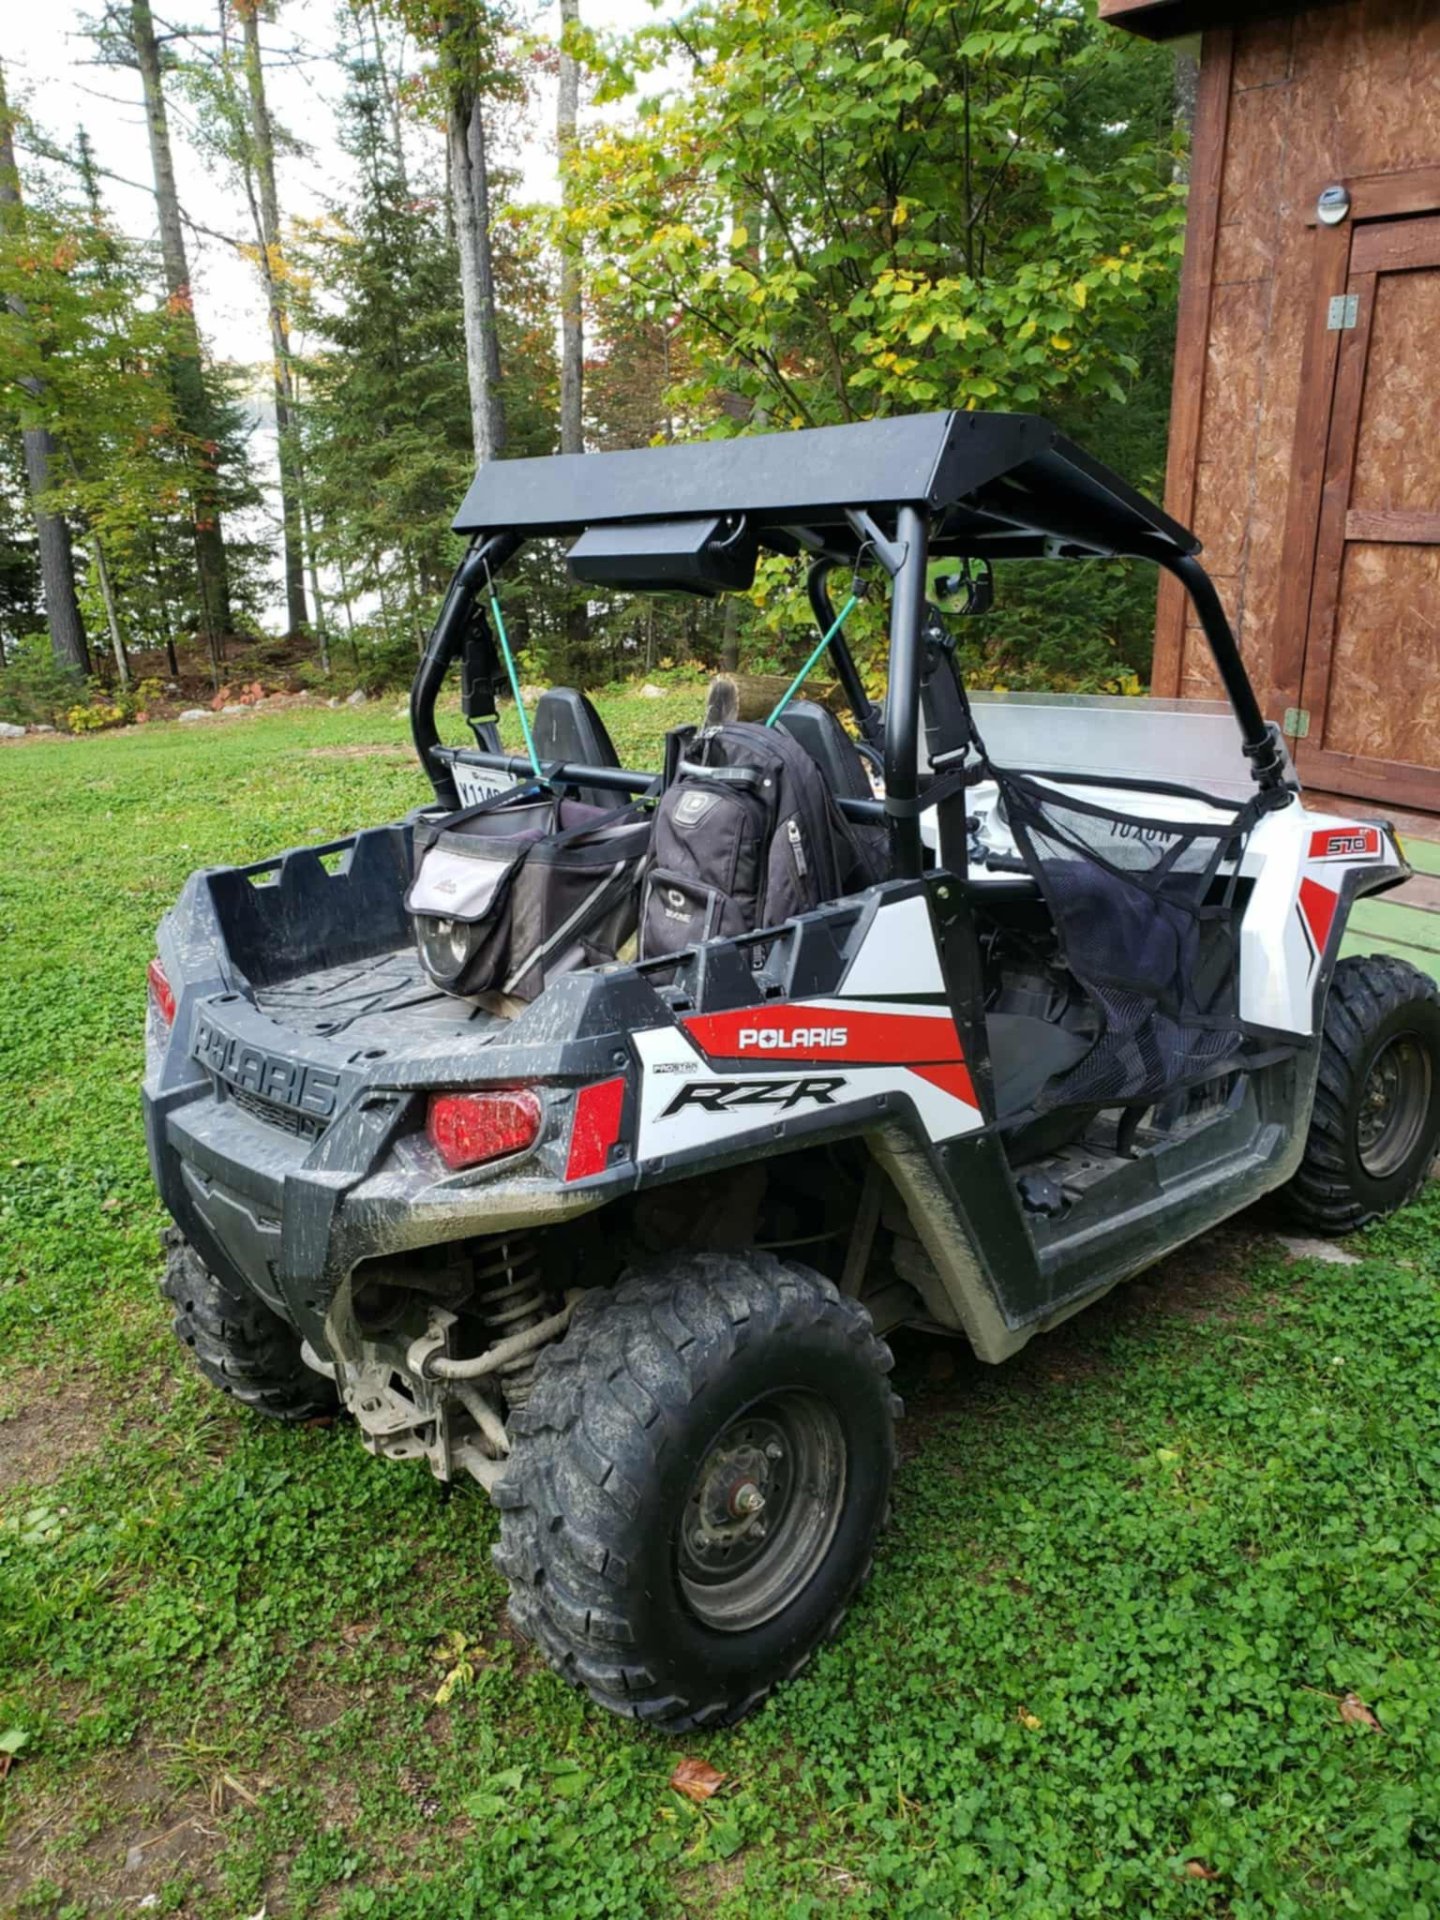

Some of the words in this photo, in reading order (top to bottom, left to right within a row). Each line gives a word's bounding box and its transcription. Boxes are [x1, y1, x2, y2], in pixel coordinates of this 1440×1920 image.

[1327, 837, 1365, 852] 570
[738, 1028, 848, 1049] POLARIS
[194, 1021, 340, 1116] POLARIS
[656, 1076, 849, 1119] RZR
